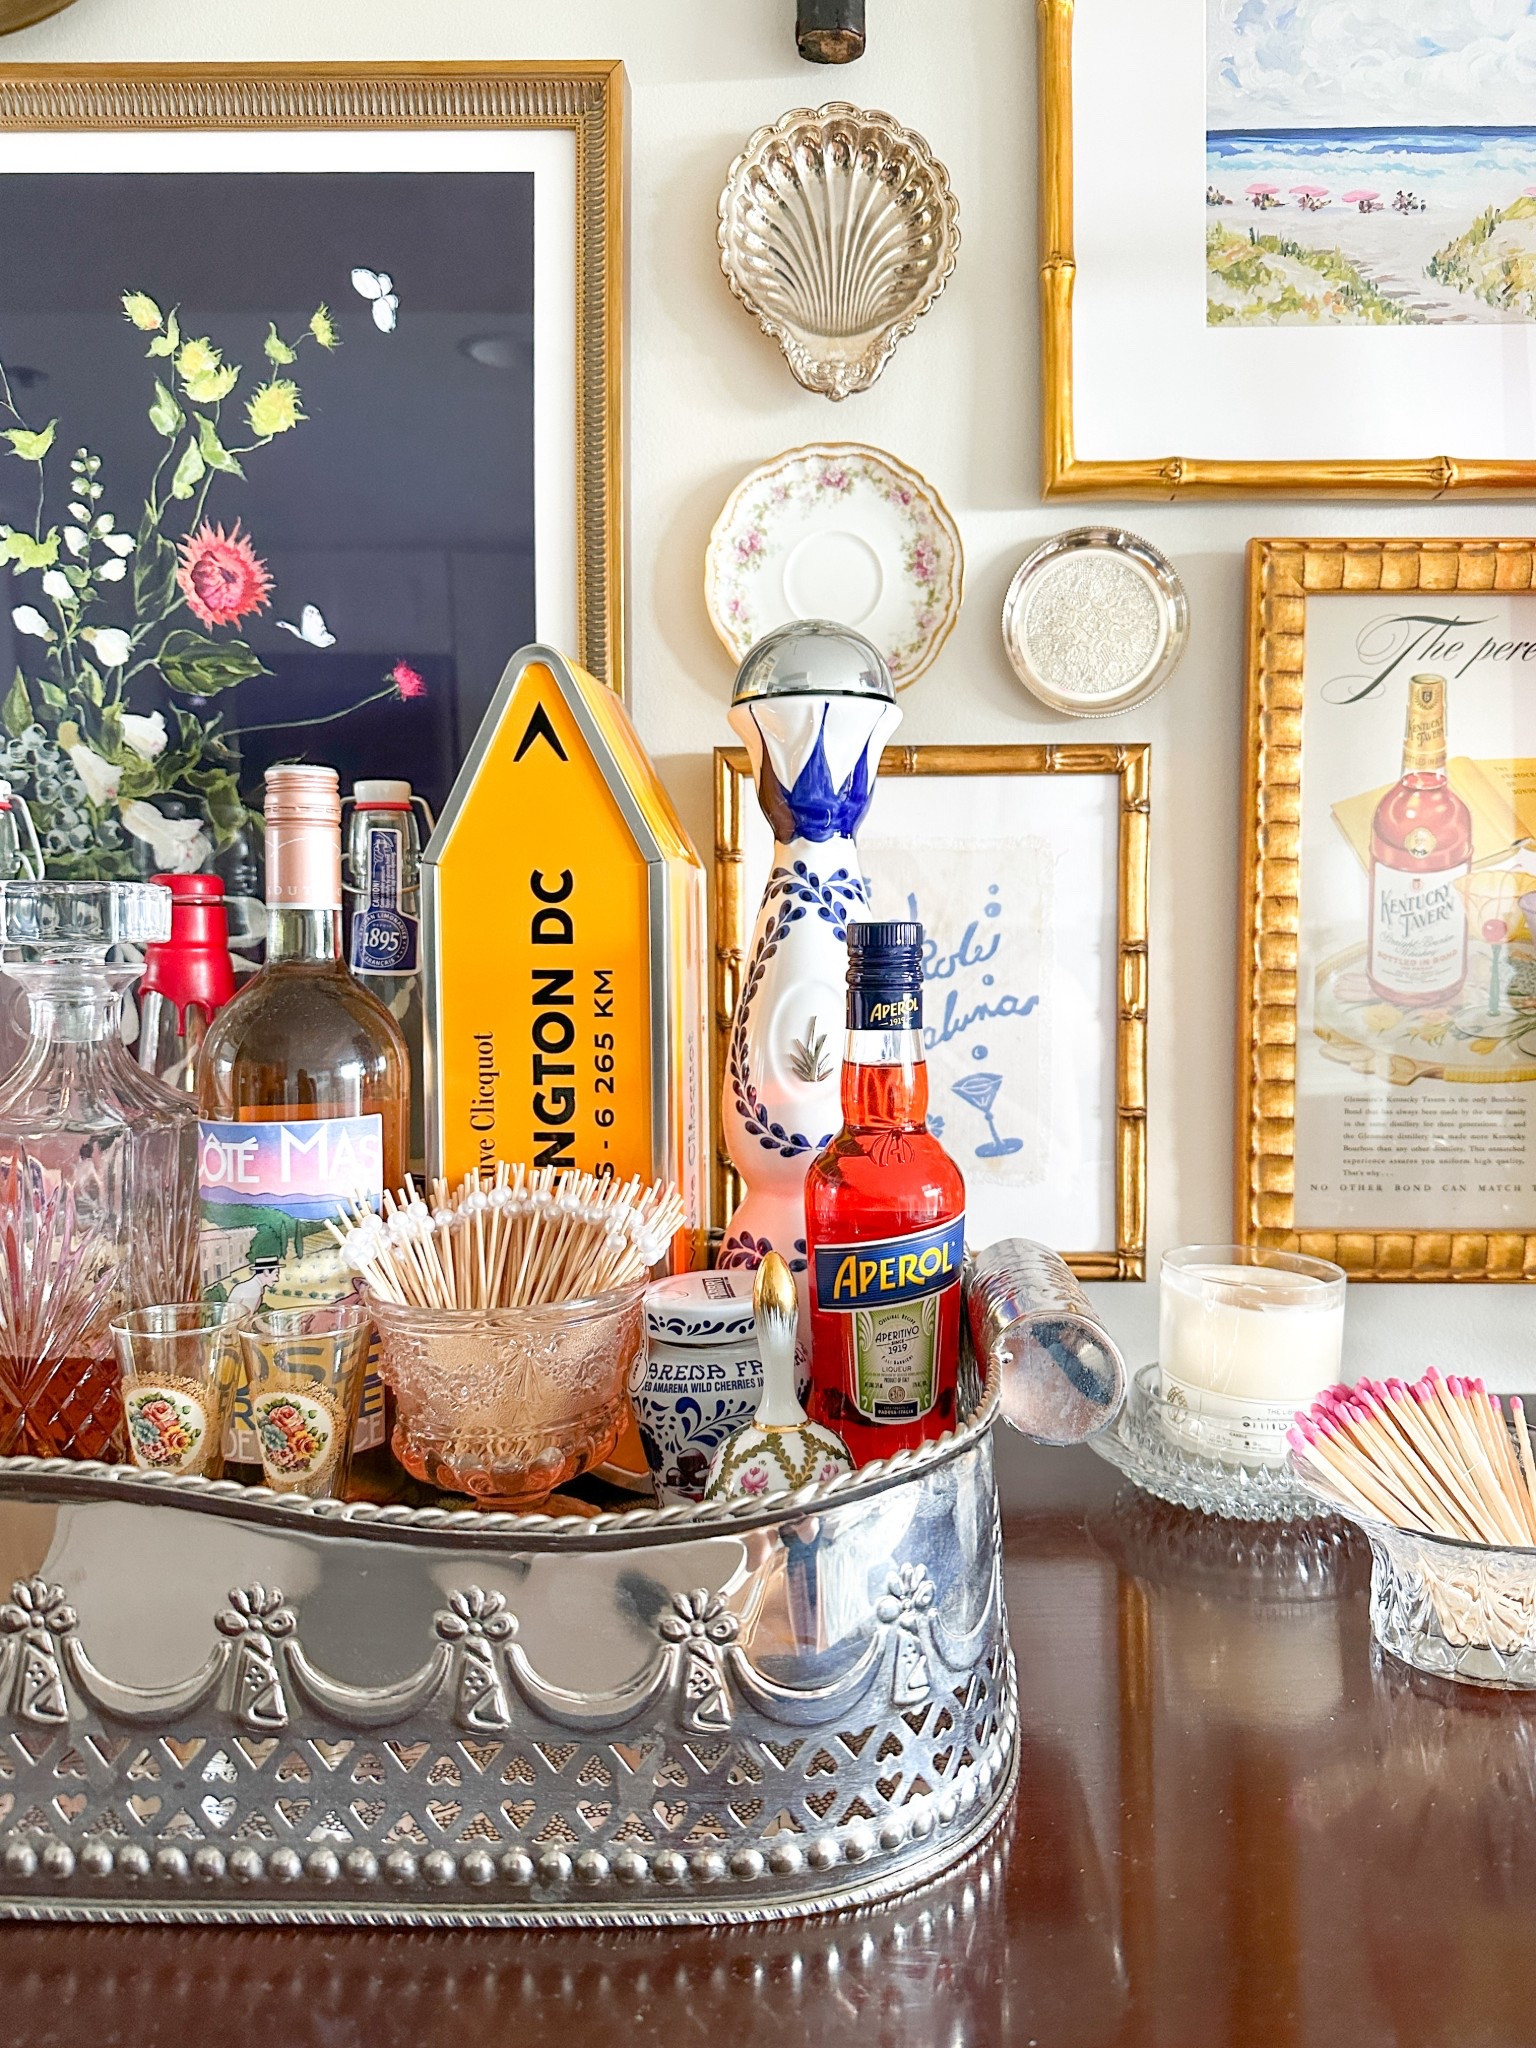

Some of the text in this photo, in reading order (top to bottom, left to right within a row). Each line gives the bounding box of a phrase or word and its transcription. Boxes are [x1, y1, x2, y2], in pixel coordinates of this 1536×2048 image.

[1321, 613, 1499, 704] The
[530, 869, 574, 945] DC
[1381, 881, 1451, 926] KENTUCKY
[1400, 896, 1455, 938] TAVERN
[363, 928, 400, 952] 1895
[594, 970, 613, 1018] KM
[870, 998, 918, 1022] APEROL
[470, 1031, 500, 1133] Clicquot
[594, 1032, 615, 1095] 265
[594, 1108, 615, 1128] 6
[280, 1124, 380, 1183] MAS
[833, 1241, 953, 1300] APEROL
[875, 1325, 920, 1343] APERITIVO
[888, 1343, 908, 1355] 1919
[653, 1381, 688, 1393] AMARENA
[690, 1382, 712, 1393] WILD
[714, 1378, 756, 1392] CHERRIES
